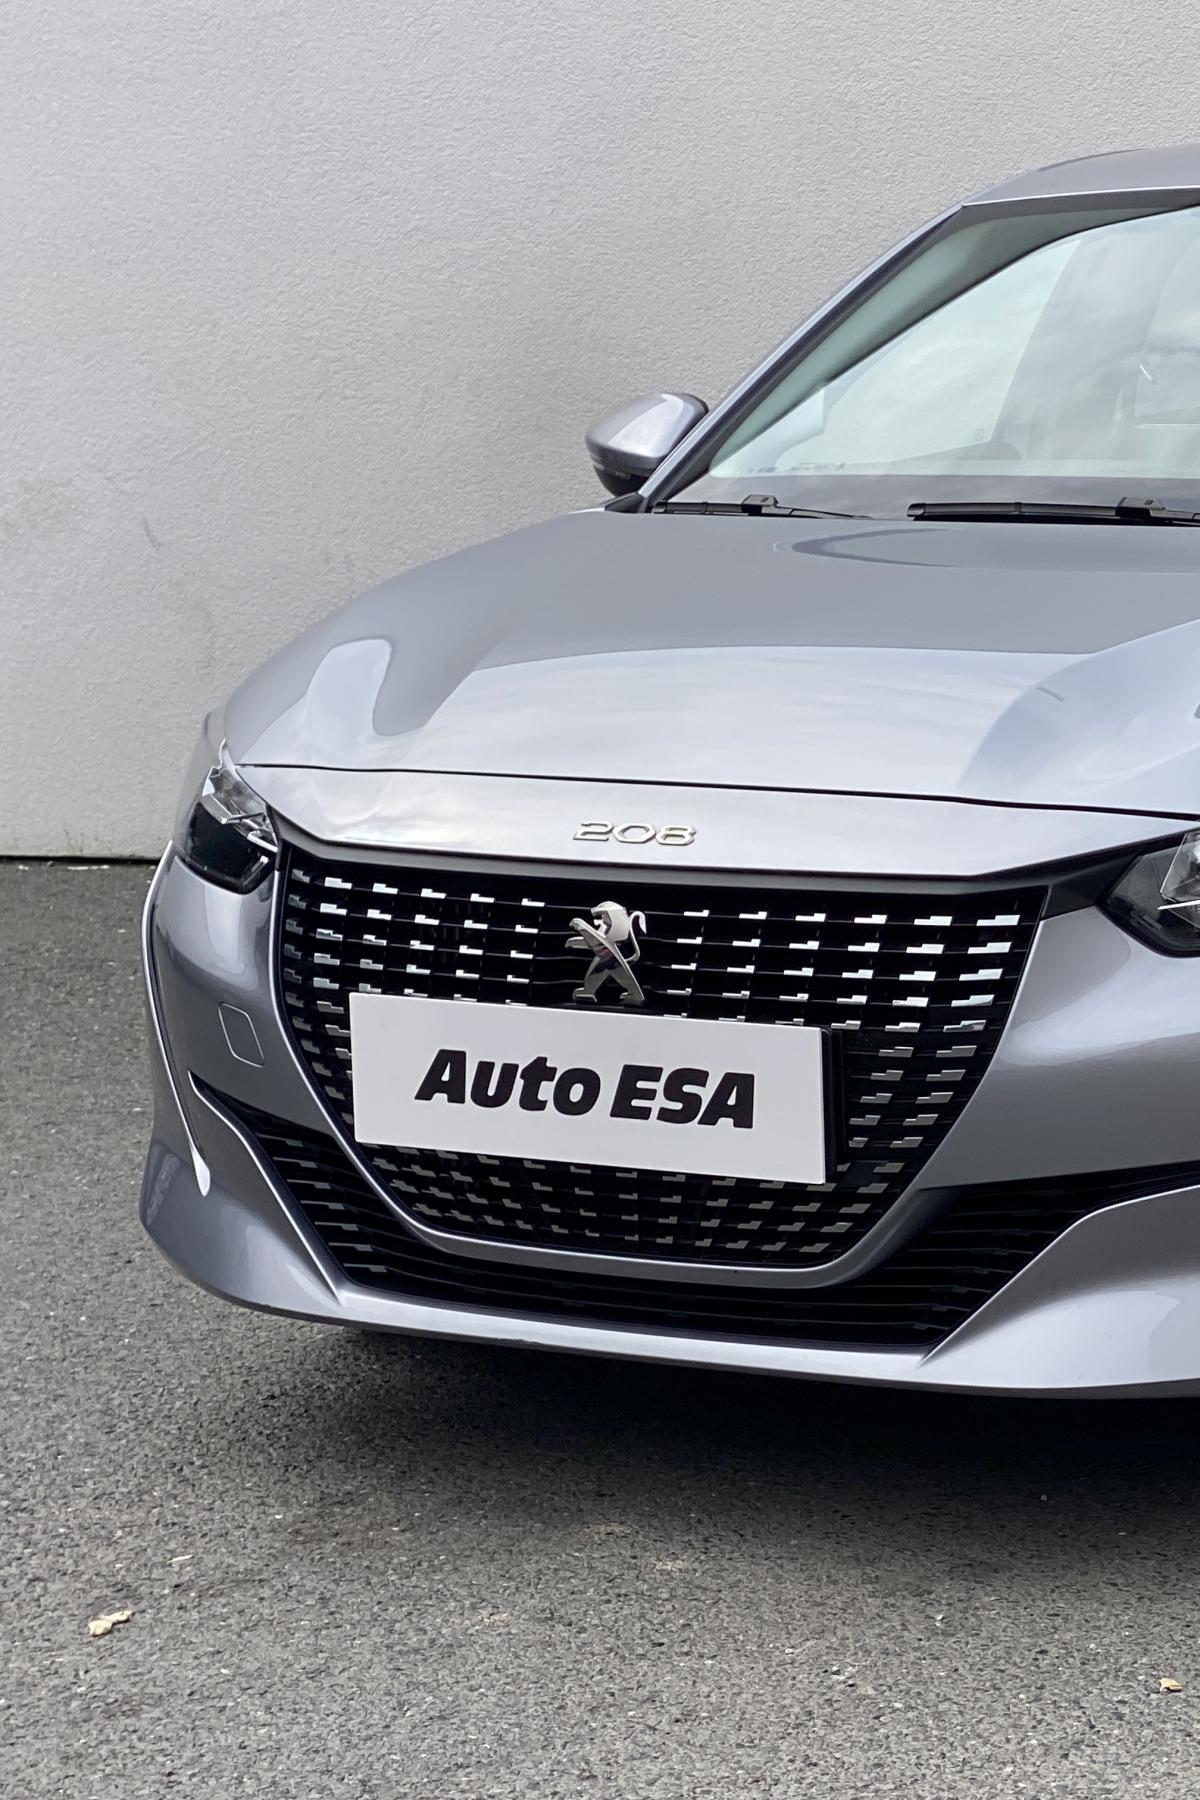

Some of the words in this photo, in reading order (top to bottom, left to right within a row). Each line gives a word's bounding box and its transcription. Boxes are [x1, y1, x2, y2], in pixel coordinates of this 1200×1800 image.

[572, 820, 697, 847] 208
[414, 1048, 601, 1116] Auto
[609, 1063, 755, 1129] ESA
